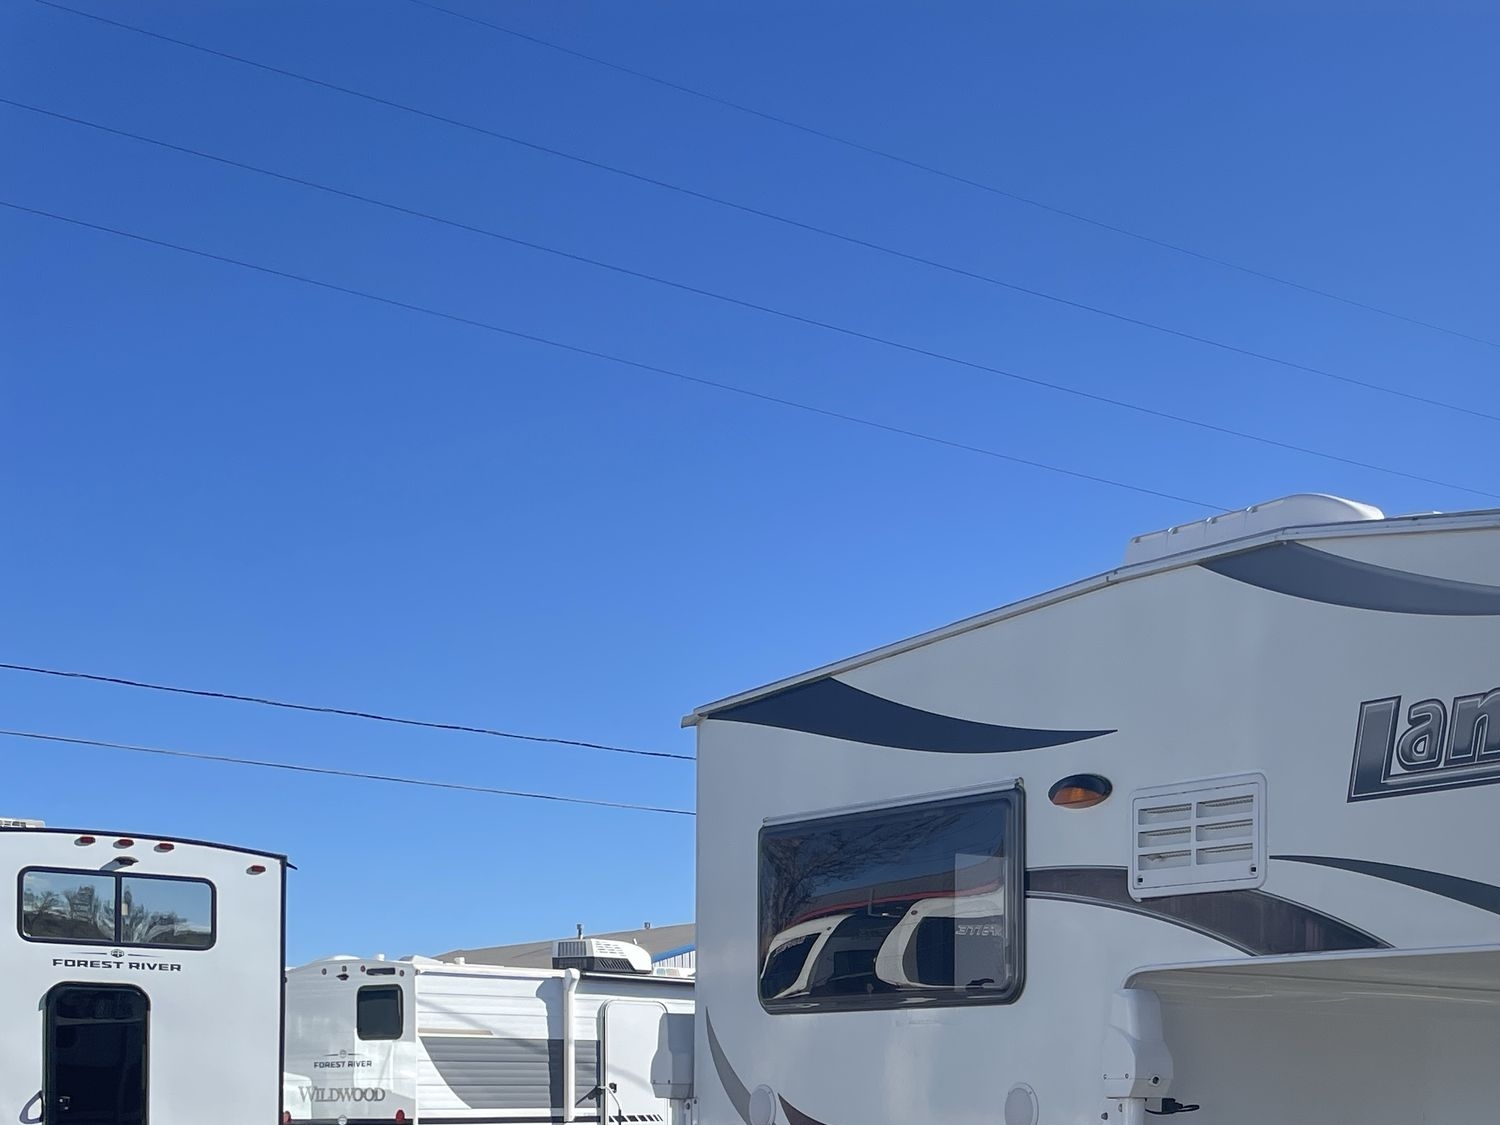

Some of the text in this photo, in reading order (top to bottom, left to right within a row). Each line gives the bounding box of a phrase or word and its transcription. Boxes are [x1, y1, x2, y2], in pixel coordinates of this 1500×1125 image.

[52, 958, 182, 972] FOREST RIVER
[313, 1060, 373, 1069] FOREST RIVER
[298, 1086, 386, 1103] WILDWOOD
